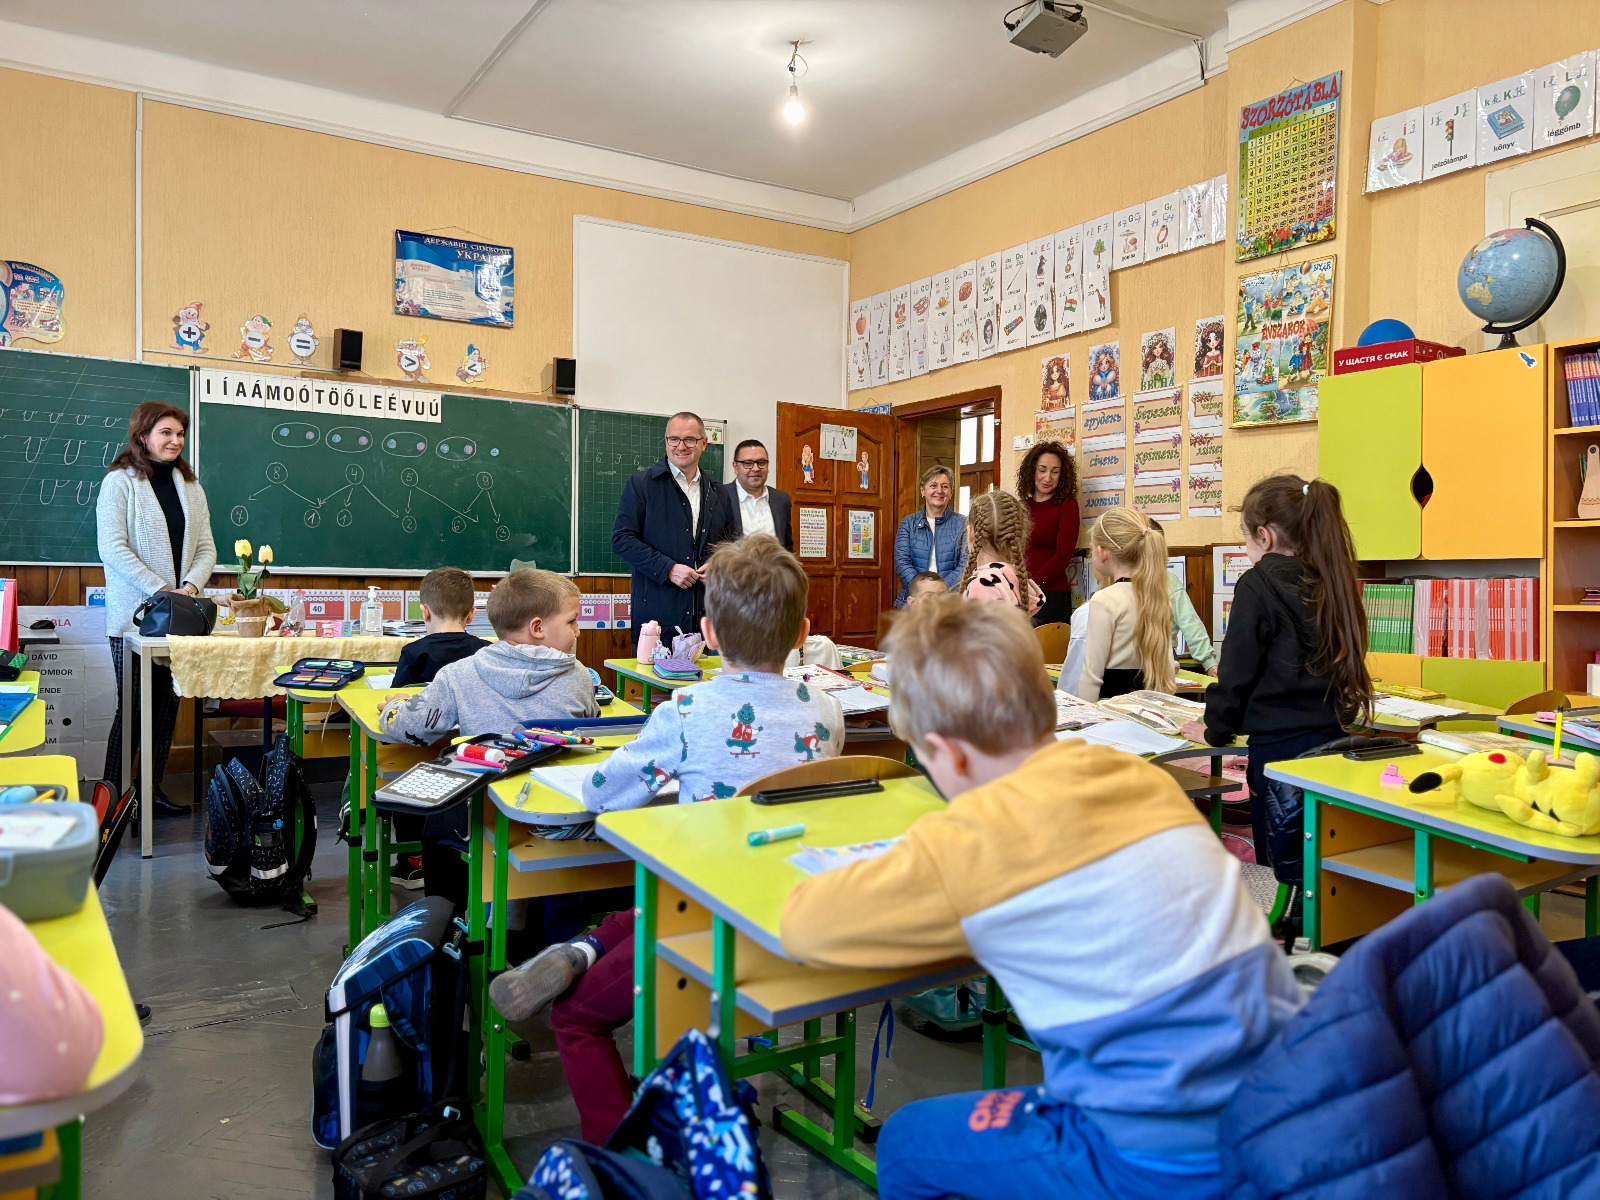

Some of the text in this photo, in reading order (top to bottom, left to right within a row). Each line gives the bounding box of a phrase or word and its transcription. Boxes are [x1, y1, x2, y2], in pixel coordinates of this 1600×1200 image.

[1566, 72, 1572, 81] L
[1504, 90, 1511, 101] K
[1241, 75, 1339, 130] SZORZÓTÁBLA
[1454, 106, 1459, 116] J
[1548, 122, 1581, 137] léggömb
[1494, 141, 1515, 152] könyv
[1313, 261, 1331, 272] NYÁR
[1346, 356, 1375, 366] ЩАСТЯ
[1384, 351, 1408, 359] СМАК
[1084, 412, 1121, 431] грудень
[1090, 454, 1119, 467] січень
[273, 466, 279, 478] 8
[351, 469, 358, 480] 4
[406, 472, 413, 483] 5
[482, 476, 489, 486] 9
[1085, 493, 1120, 508] лютий
[307, 513, 315, 524] 1
[340, 514, 347, 523] 1
[406, 519, 413, 529] 2
[454, 520, 461, 530] 6
[312, 605, 322, 613] 40
[31, 652, 58, 661] DÁVID
